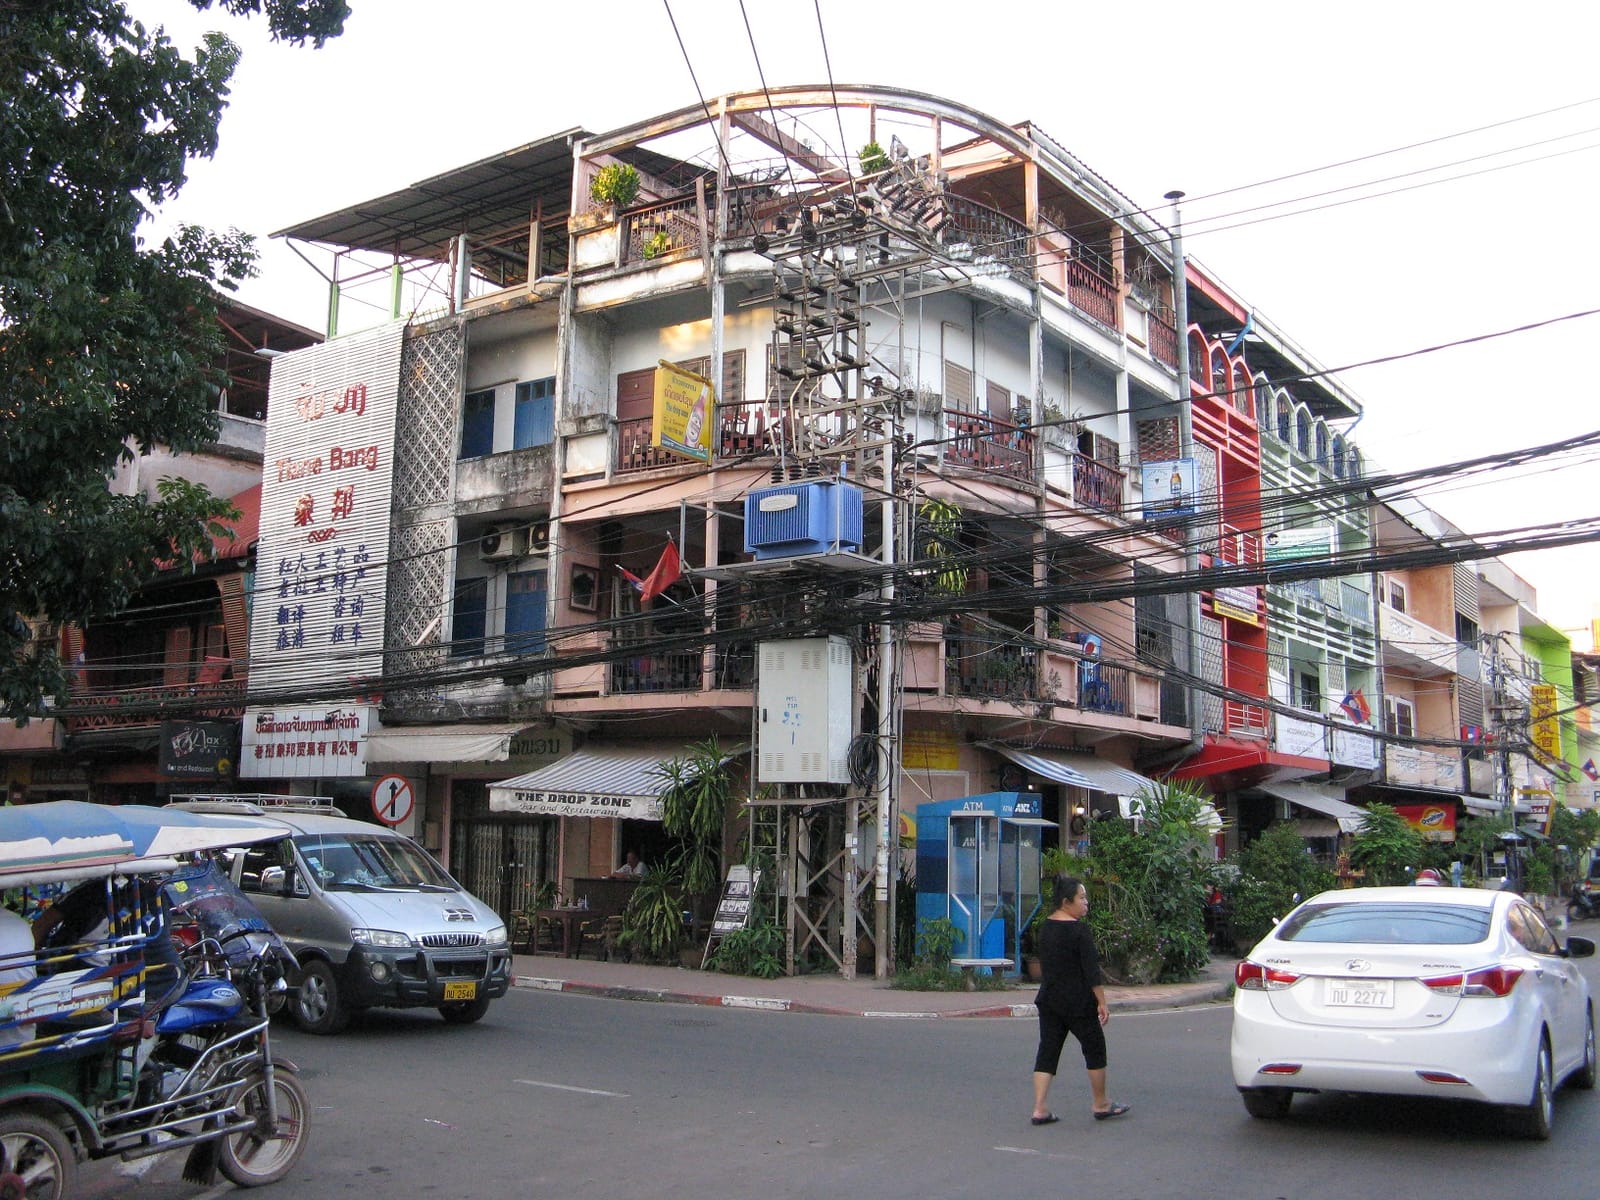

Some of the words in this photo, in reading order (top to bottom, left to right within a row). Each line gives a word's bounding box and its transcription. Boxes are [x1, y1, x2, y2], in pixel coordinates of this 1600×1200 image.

[330, 446, 378, 471] Bang
[294, 486, 354, 526] 象邦
[515, 791, 545, 804] THE
[547, 794, 587, 806] DROP
[590, 796, 633, 808] ZONE
[963, 801, 984, 812] ATM
[540, 804, 558, 813] and
[560, 805, 620, 818] Restaurant
[1014, 803, 1031, 813] ANZ
[1354, 990, 1386, 1005] 2277
